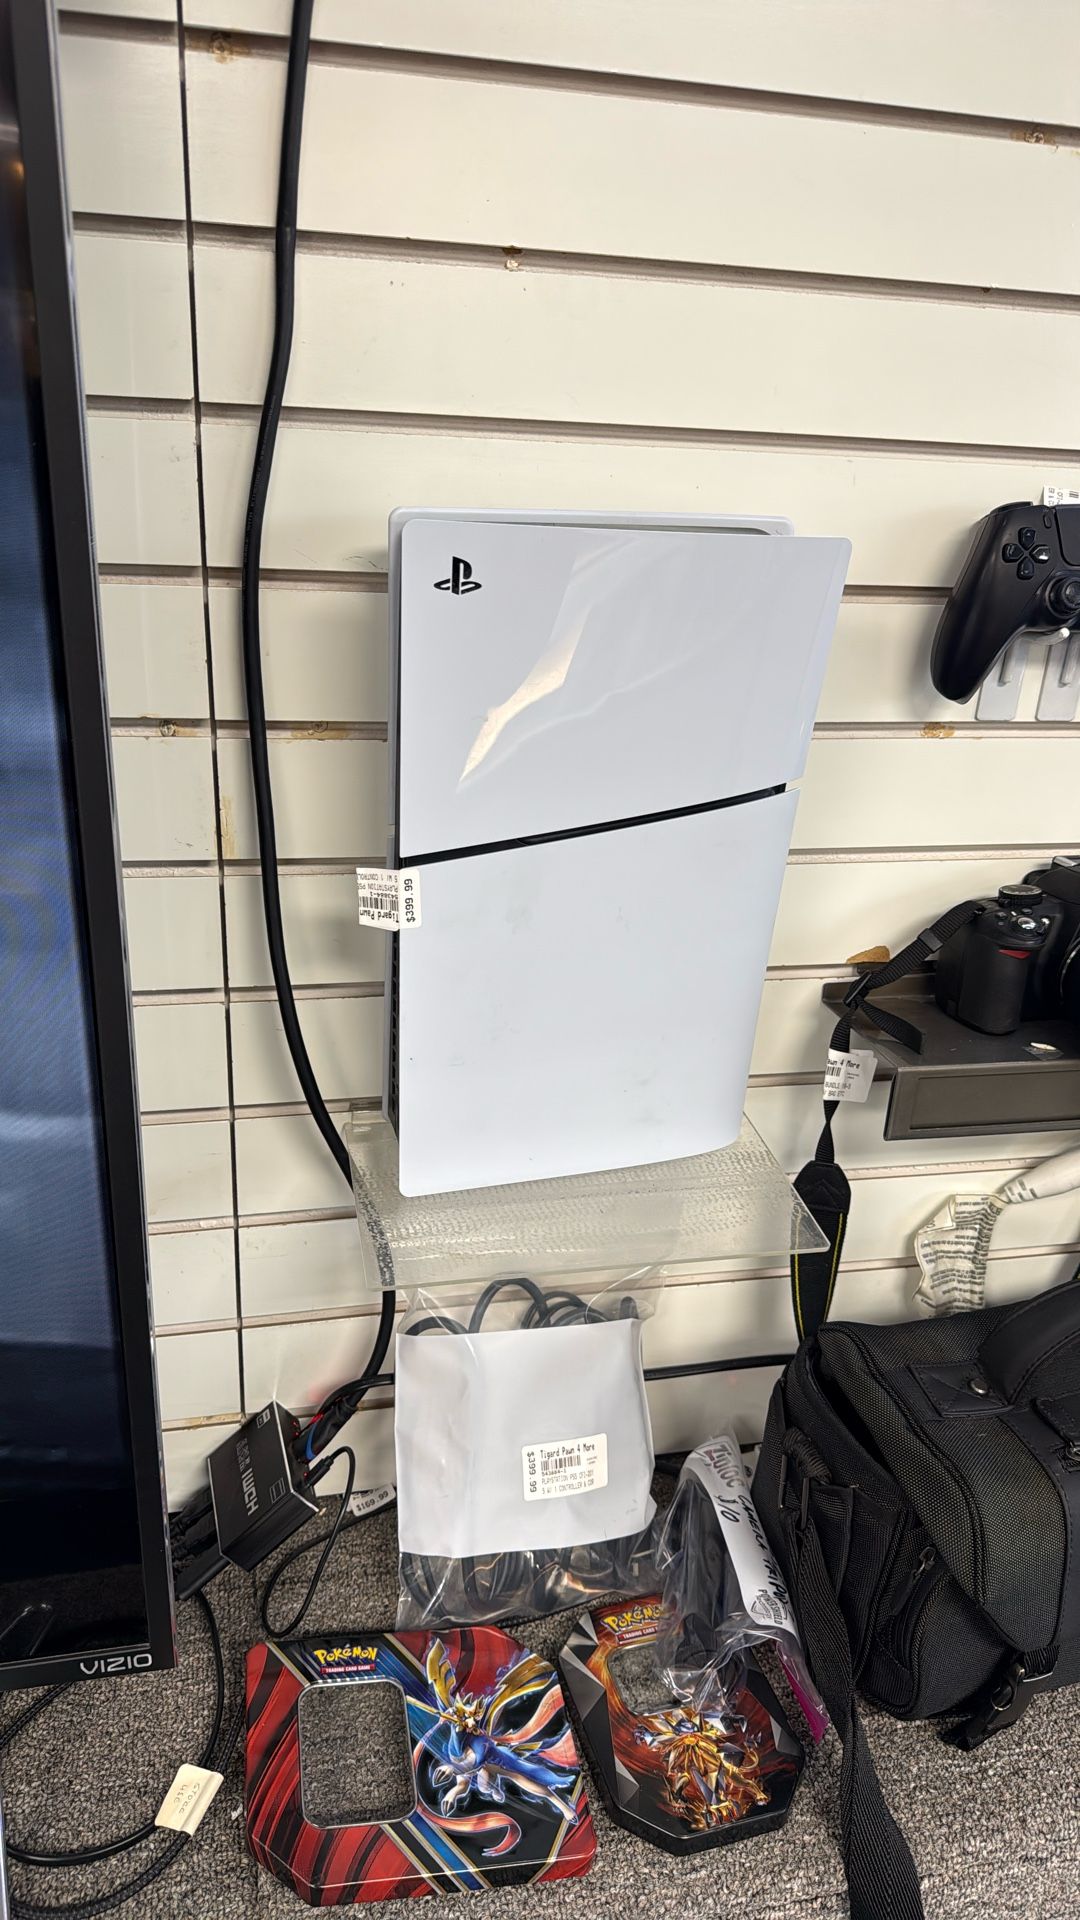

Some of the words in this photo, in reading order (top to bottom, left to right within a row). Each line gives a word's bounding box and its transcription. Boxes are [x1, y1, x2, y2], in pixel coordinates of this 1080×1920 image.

[368, 883, 398, 893] PLAYSTATION
[404, 879, 416, 922] $399.99
[378, 911, 399, 923] Tigard
[846, 1060, 860, 1069] More
[540, 1448, 559, 1460] Tigard
[562, 1446, 575, 1456] Pawn
[583, 1443, 595, 1452] More
[527, 1451, 537, 1493] $399.99
[542, 1474, 569, 1485] PLAYSTATION
[559, 1481, 582, 1492] CONTROLLER
[241, 1467, 259, 1516] HDMI
[356, 1490, 389, 1511] $169.99
[623, 1630, 642, 1639] TRADING
[80, 1653, 152, 1675] VIZIO
